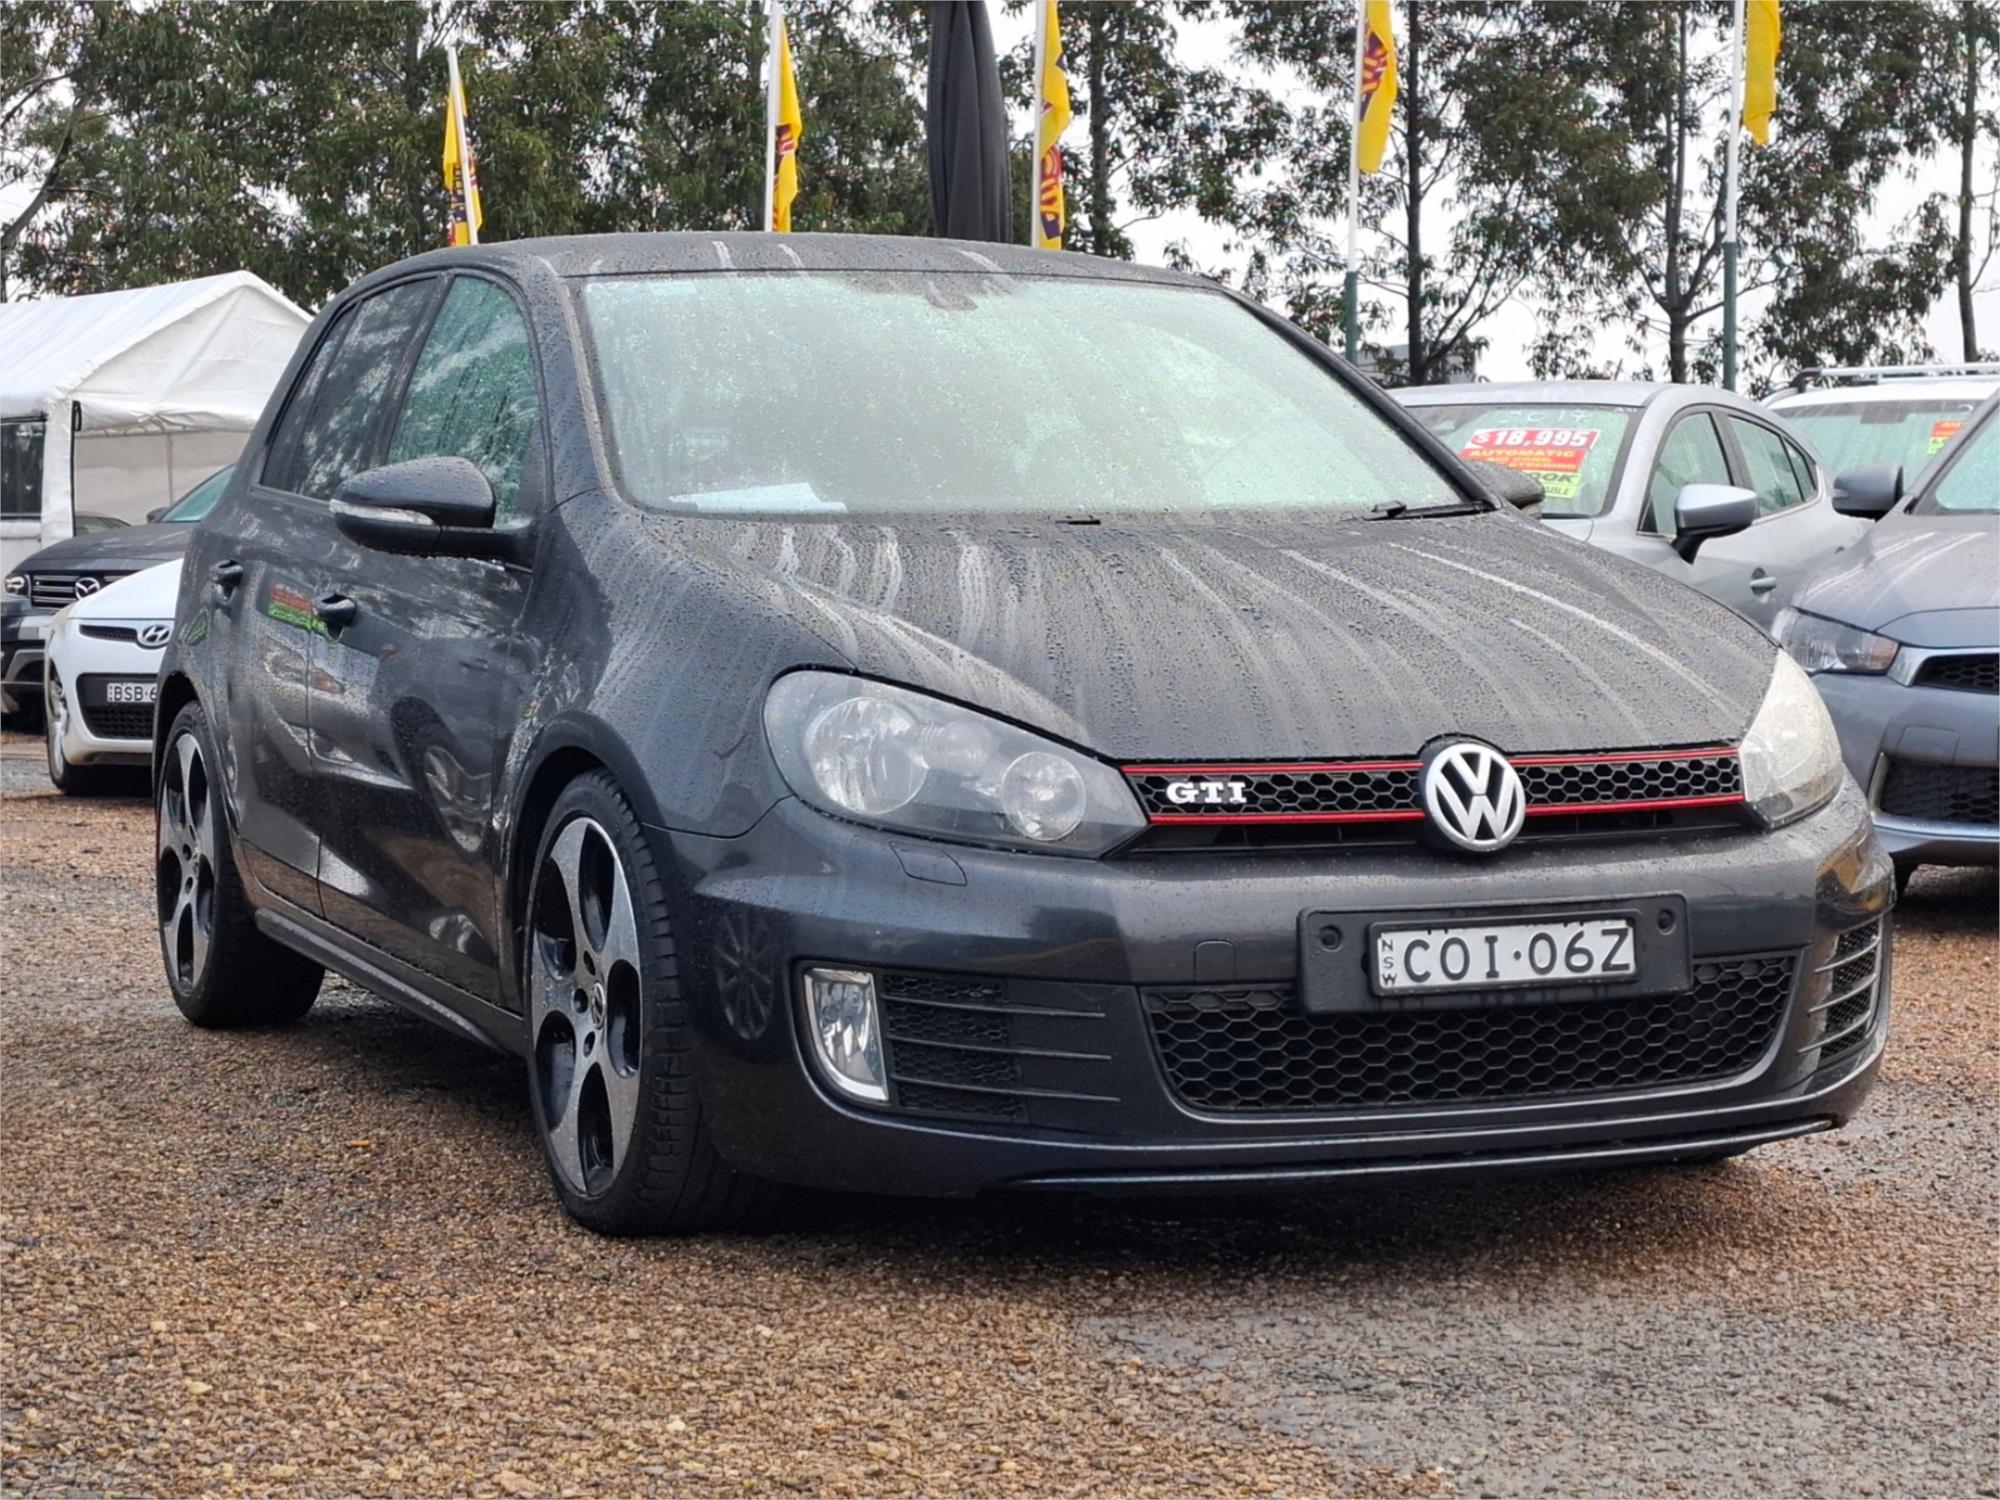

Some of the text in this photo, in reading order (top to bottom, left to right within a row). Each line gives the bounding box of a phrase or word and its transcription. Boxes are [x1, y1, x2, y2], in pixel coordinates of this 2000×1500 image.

[1470, 430, 1589, 447] $18,995
[1470, 449, 1576, 458] AUTOMATIC
[1166, 780, 1247, 804] GTI
